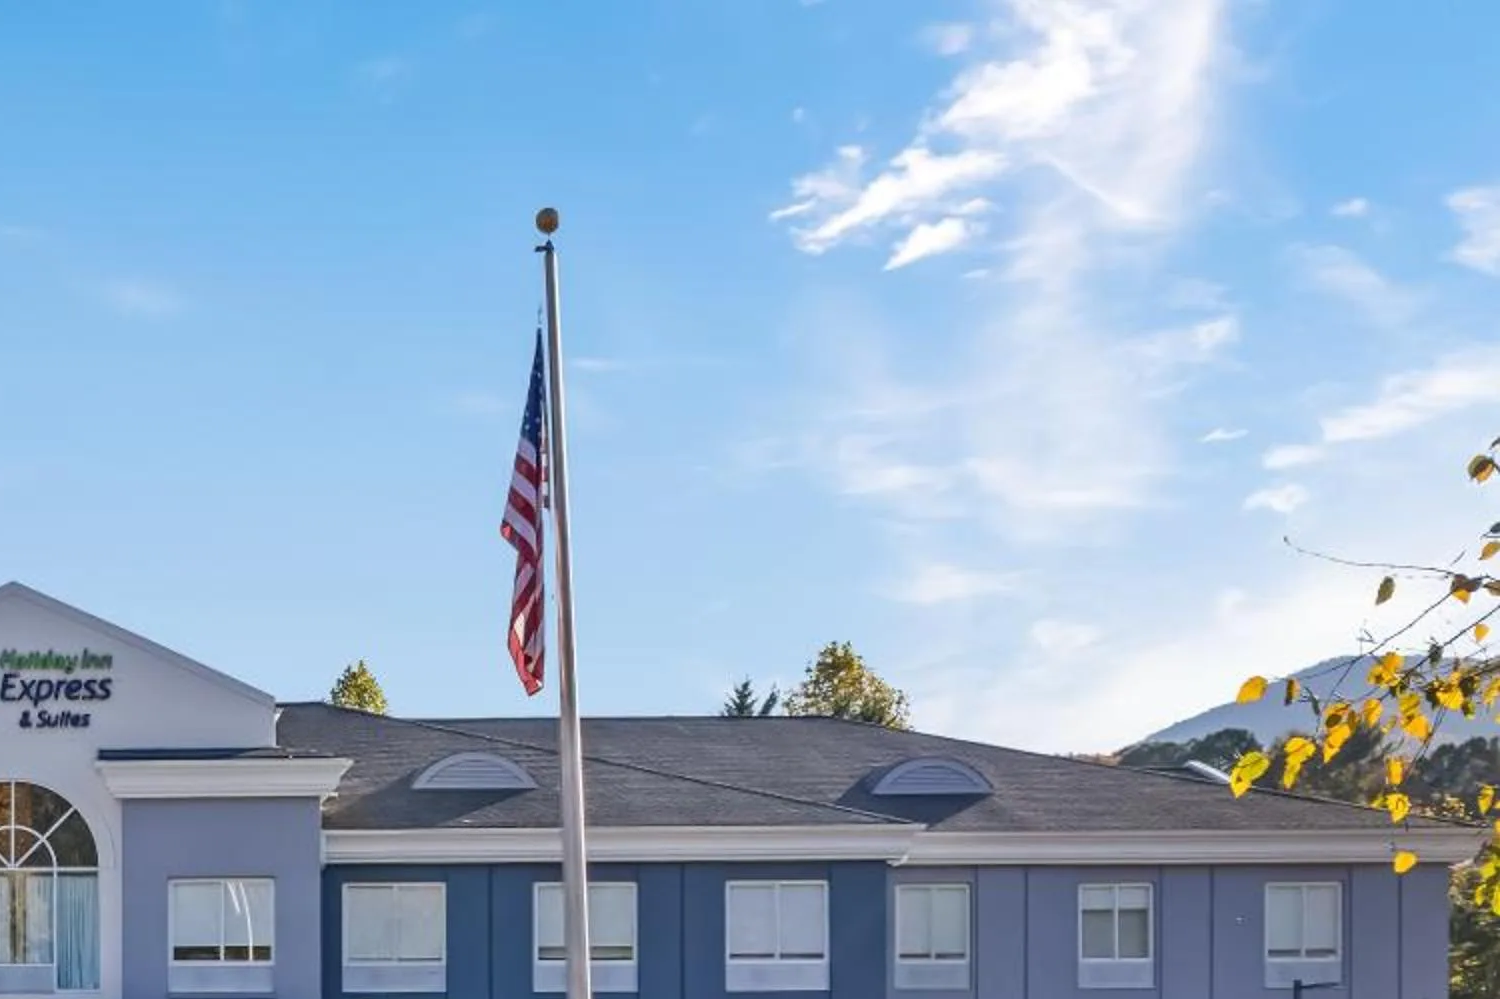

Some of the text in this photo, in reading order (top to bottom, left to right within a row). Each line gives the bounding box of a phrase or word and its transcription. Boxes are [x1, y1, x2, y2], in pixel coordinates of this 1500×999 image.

[0, 648, 113, 674] Holiday Inn
[0, 672, 113, 707] Express
[19, 710, 92, 728] & Suites
